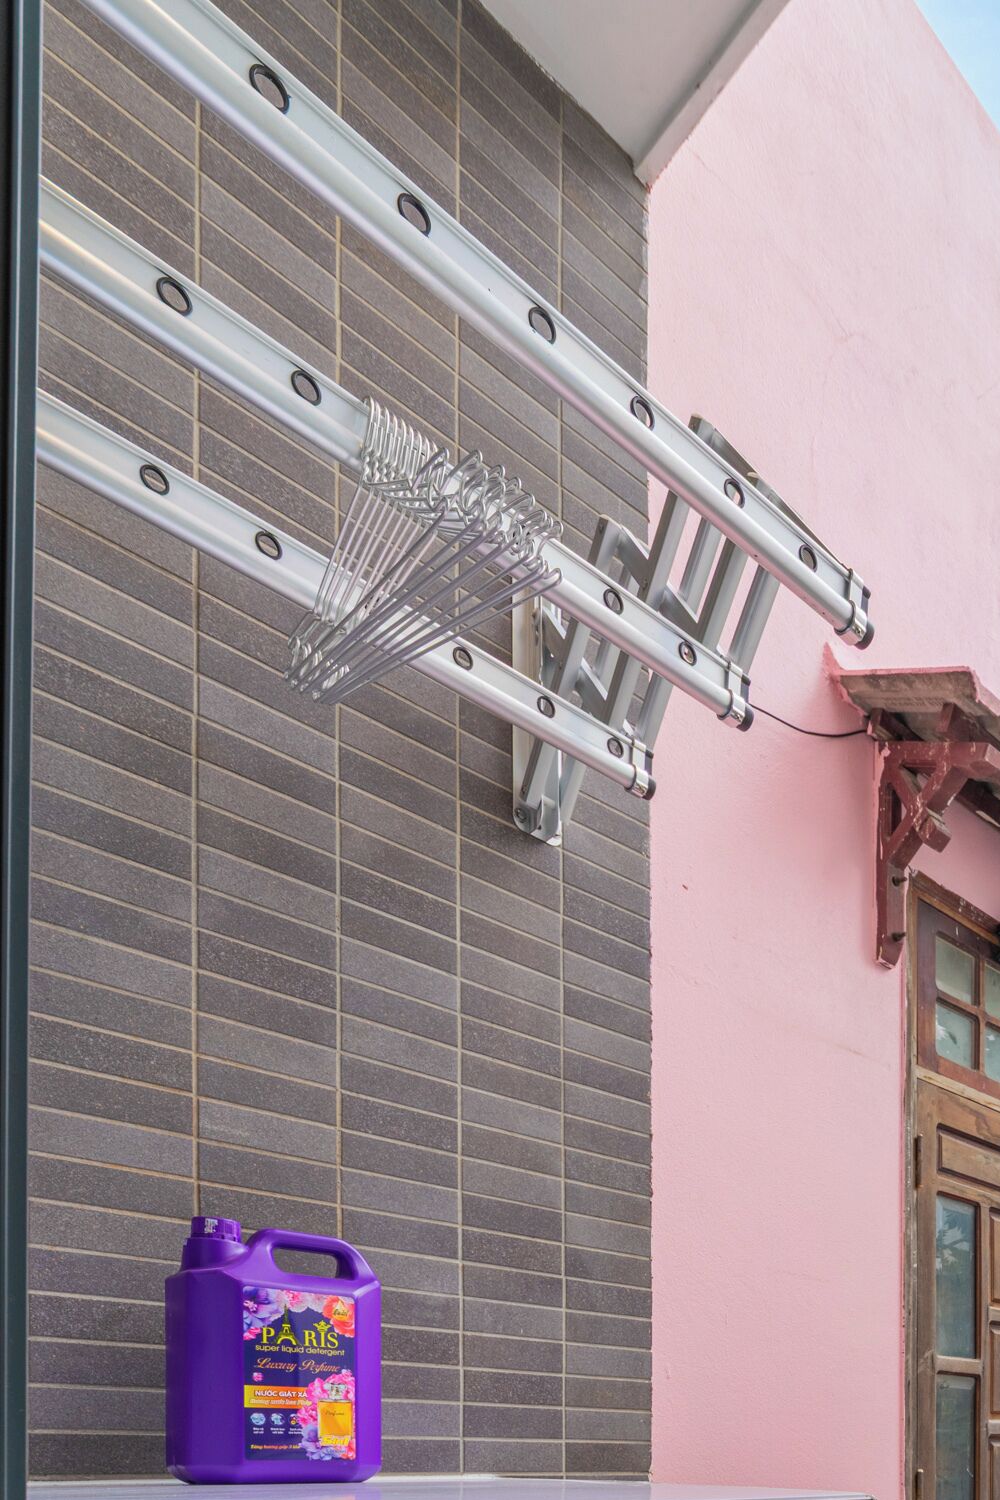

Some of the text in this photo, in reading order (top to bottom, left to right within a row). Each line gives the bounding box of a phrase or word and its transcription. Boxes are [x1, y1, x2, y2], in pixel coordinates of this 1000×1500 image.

[261, 1323, 339, 1348] PARIS
[281, 1345, 304, 1353] liquid
[306, 1346, 345, 1357] detergent
[256, 1358, 342, 1374] Luxury Perfume
[255, 1389, 278, 1397] NƯỚC
